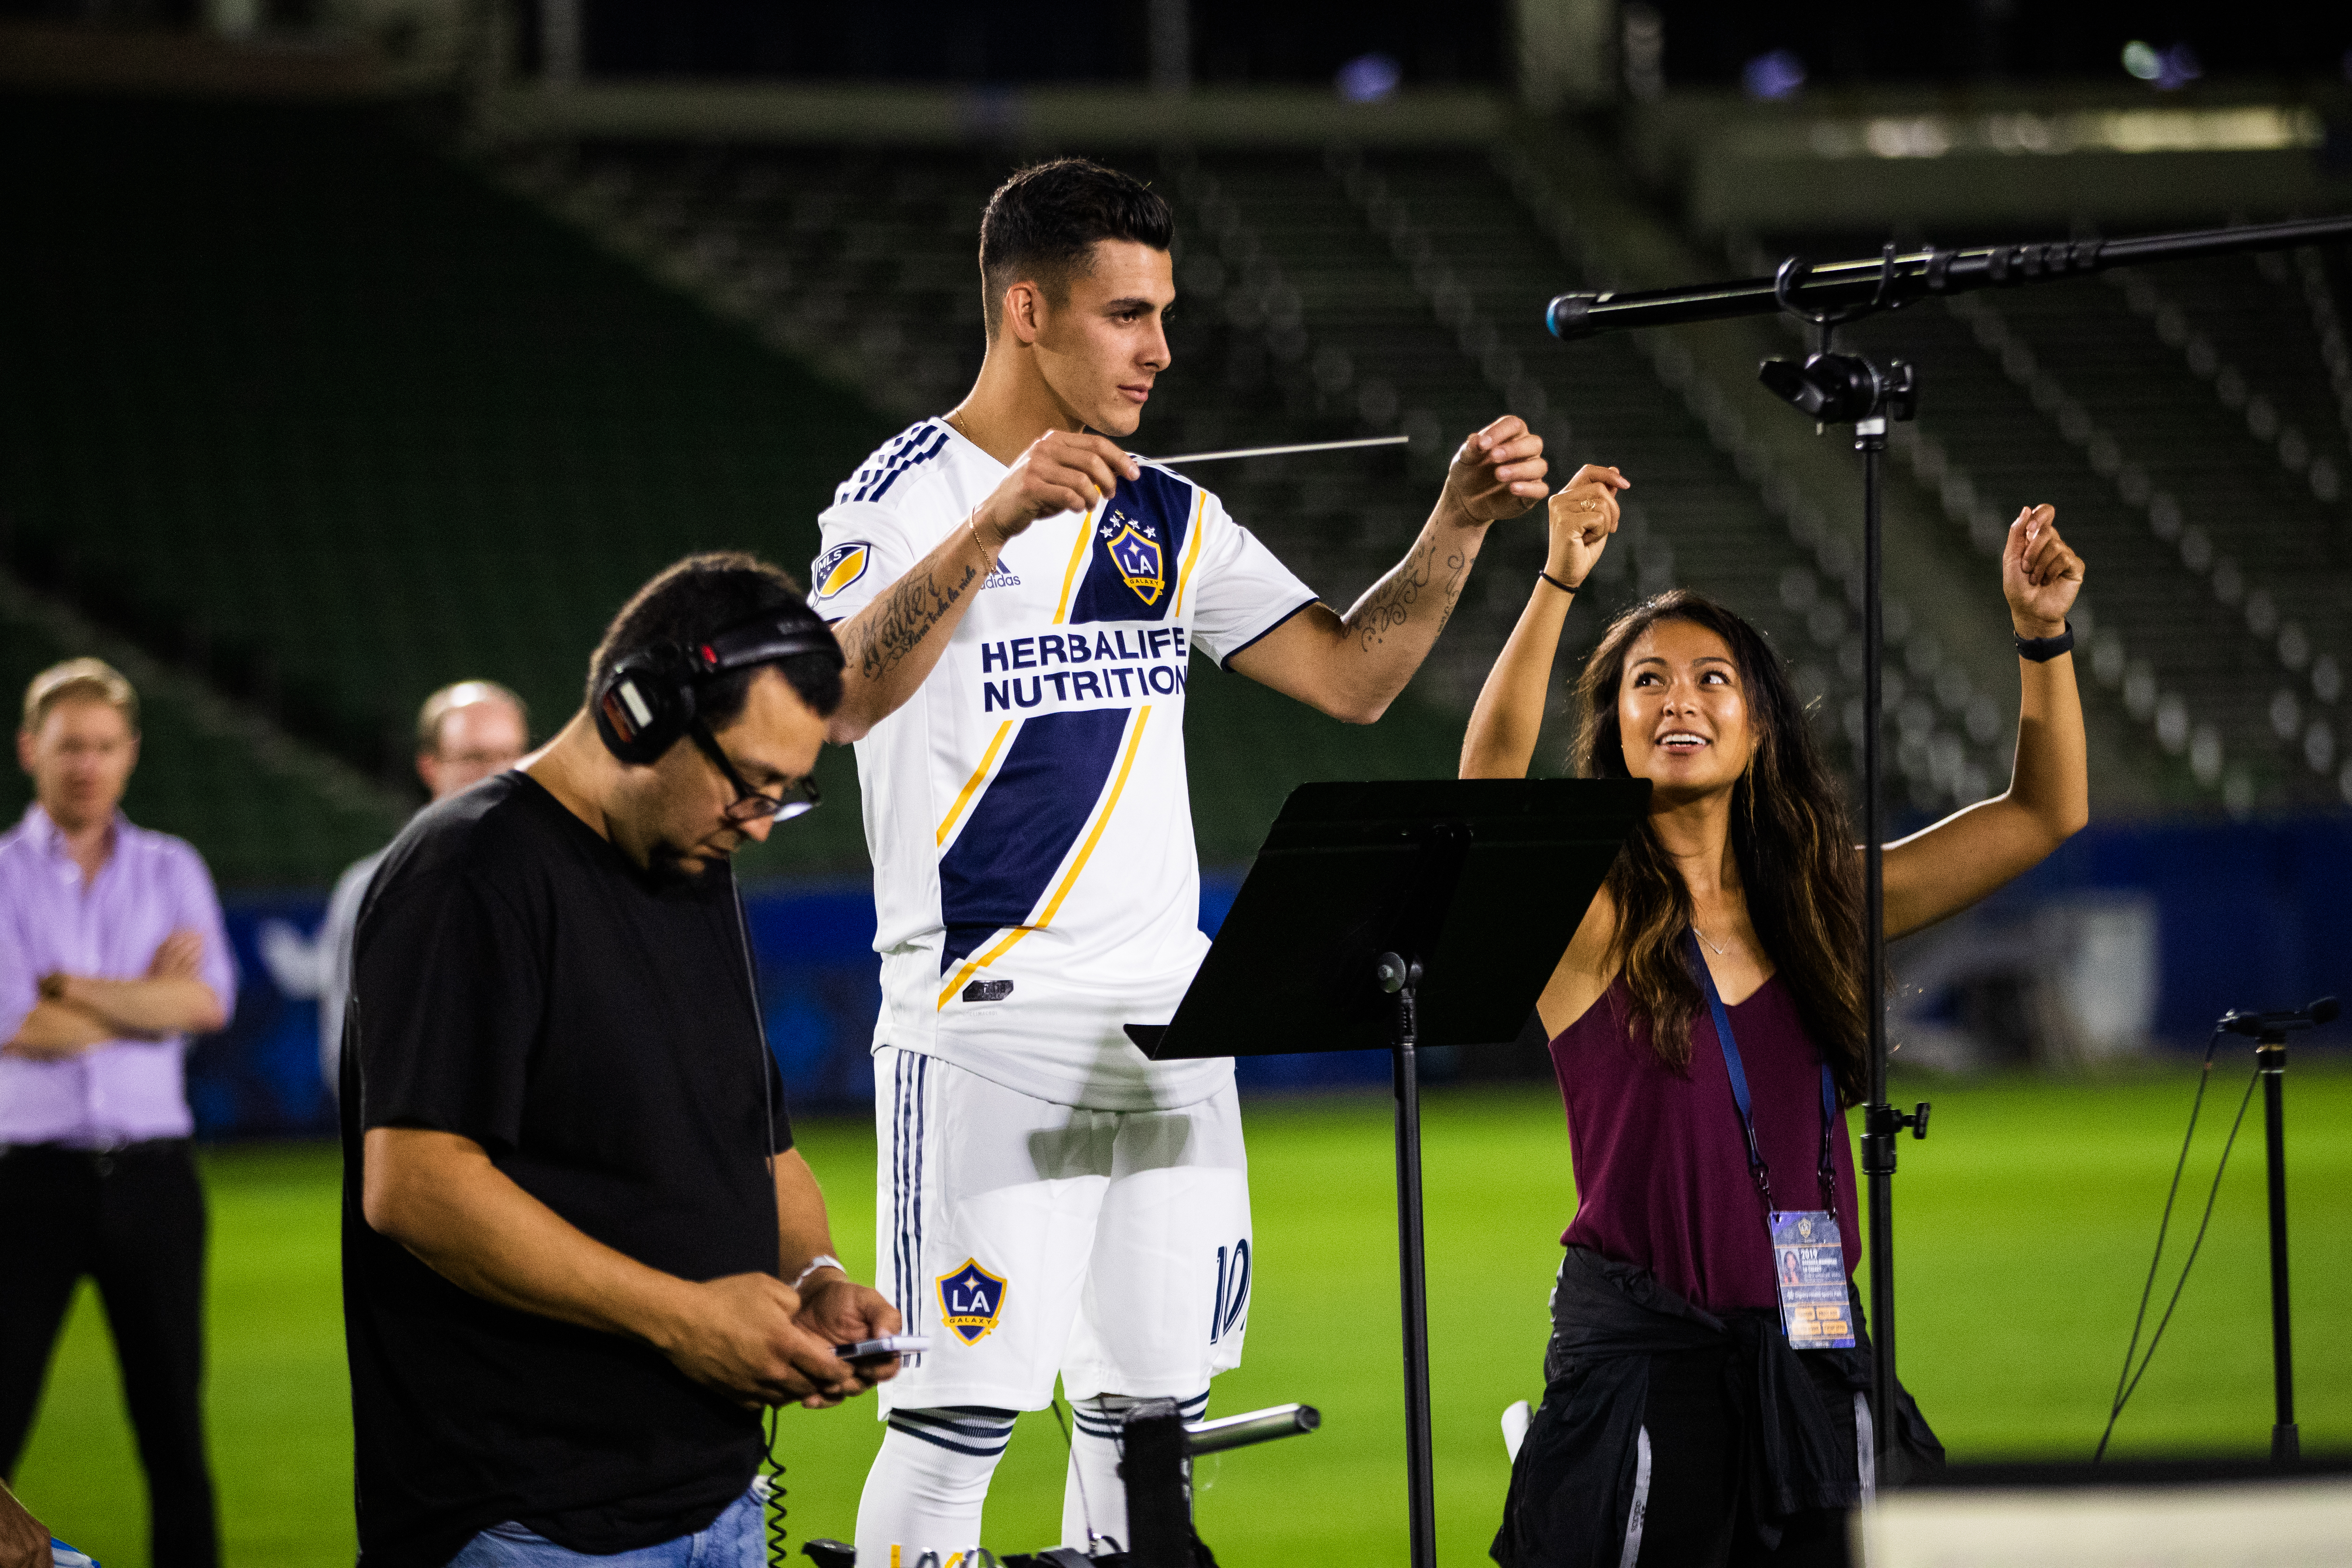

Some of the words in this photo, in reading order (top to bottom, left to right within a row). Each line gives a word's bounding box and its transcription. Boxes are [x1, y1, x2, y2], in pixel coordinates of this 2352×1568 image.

[818, 550, 842, 573] MLS
[1123, 555, 1155, 574] LA
[982, 627, 1187, 673] HERBALIFE
[984, 665, 1187, 712] NUTRITION
[1801, 1248, 1817, 1260] 2019
[953, 1289, 990, 1312] LA
[1210, 1238, 1251, 1345] 10
